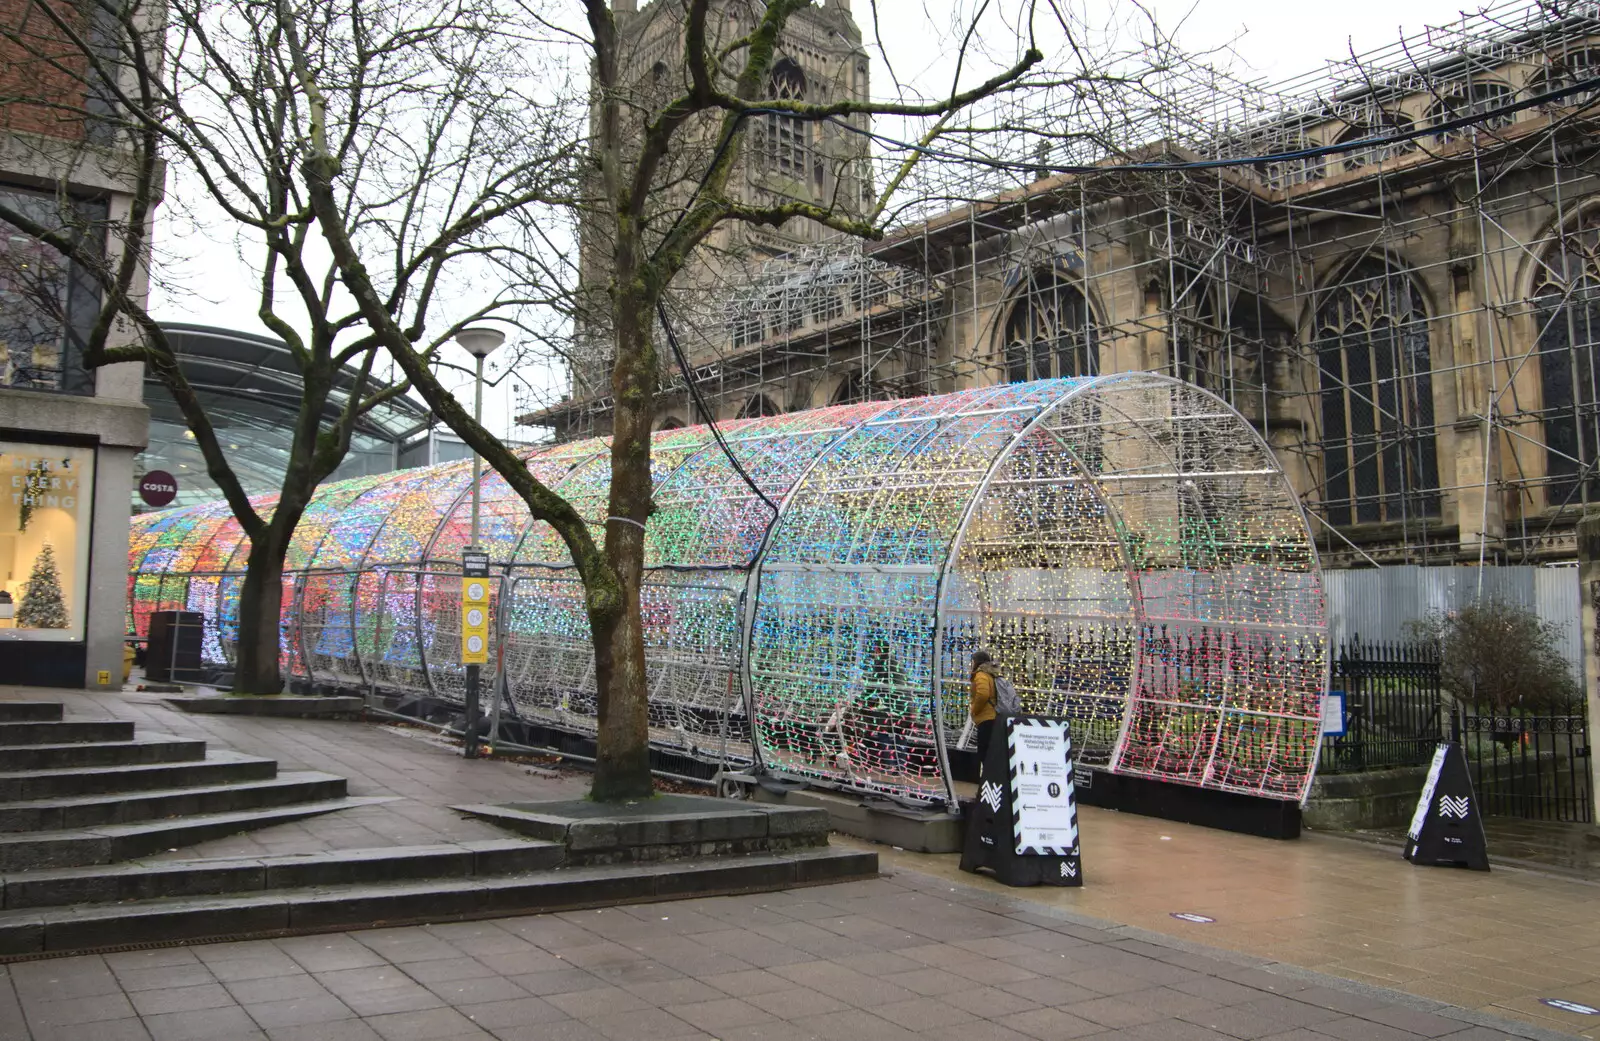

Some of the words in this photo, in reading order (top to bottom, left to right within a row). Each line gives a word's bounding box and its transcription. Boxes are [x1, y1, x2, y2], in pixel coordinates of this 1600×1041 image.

[11, 475, 76, 490] EVERY
[143, 483, 175, 493] COSTA
[12, 493, 76, 509] THING
